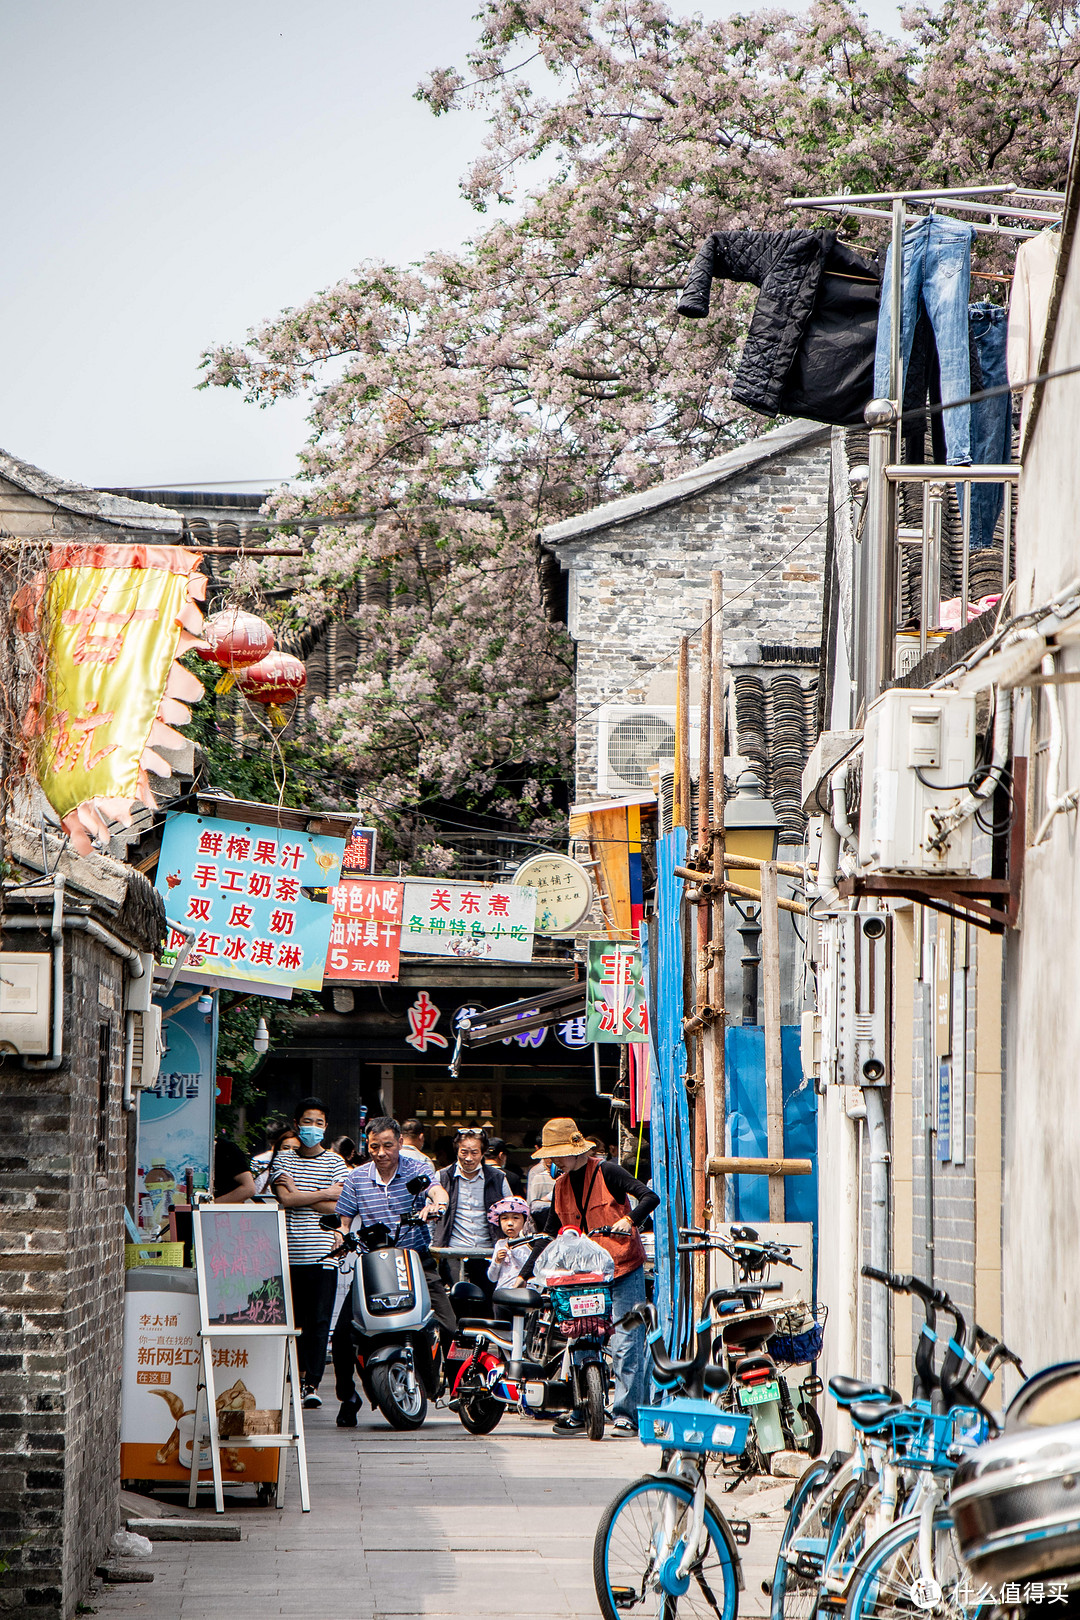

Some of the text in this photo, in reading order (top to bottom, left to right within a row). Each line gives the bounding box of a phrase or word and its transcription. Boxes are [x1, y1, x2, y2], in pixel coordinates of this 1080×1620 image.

[198, 830, 305, 870] 鲜榨果汁
[194, 865, 300, 902] 手工奶茶
[331, 886, 398, 914] 特色小吃
[430, 889, 511, 917] 关东煮
[187, 897, 294, 935] 双皮奶
[408, 914, 528, 942] 各种特色小吃
[329, 917, 397, 947] 油炸臭干
[168, 928, 302, 969] 网红冰淇淋
[600, 951, 645, 986] 宝
[139, 1335, 193, 1346] 你一直在找的
[138, 1373, 170, 1384] 在这里
